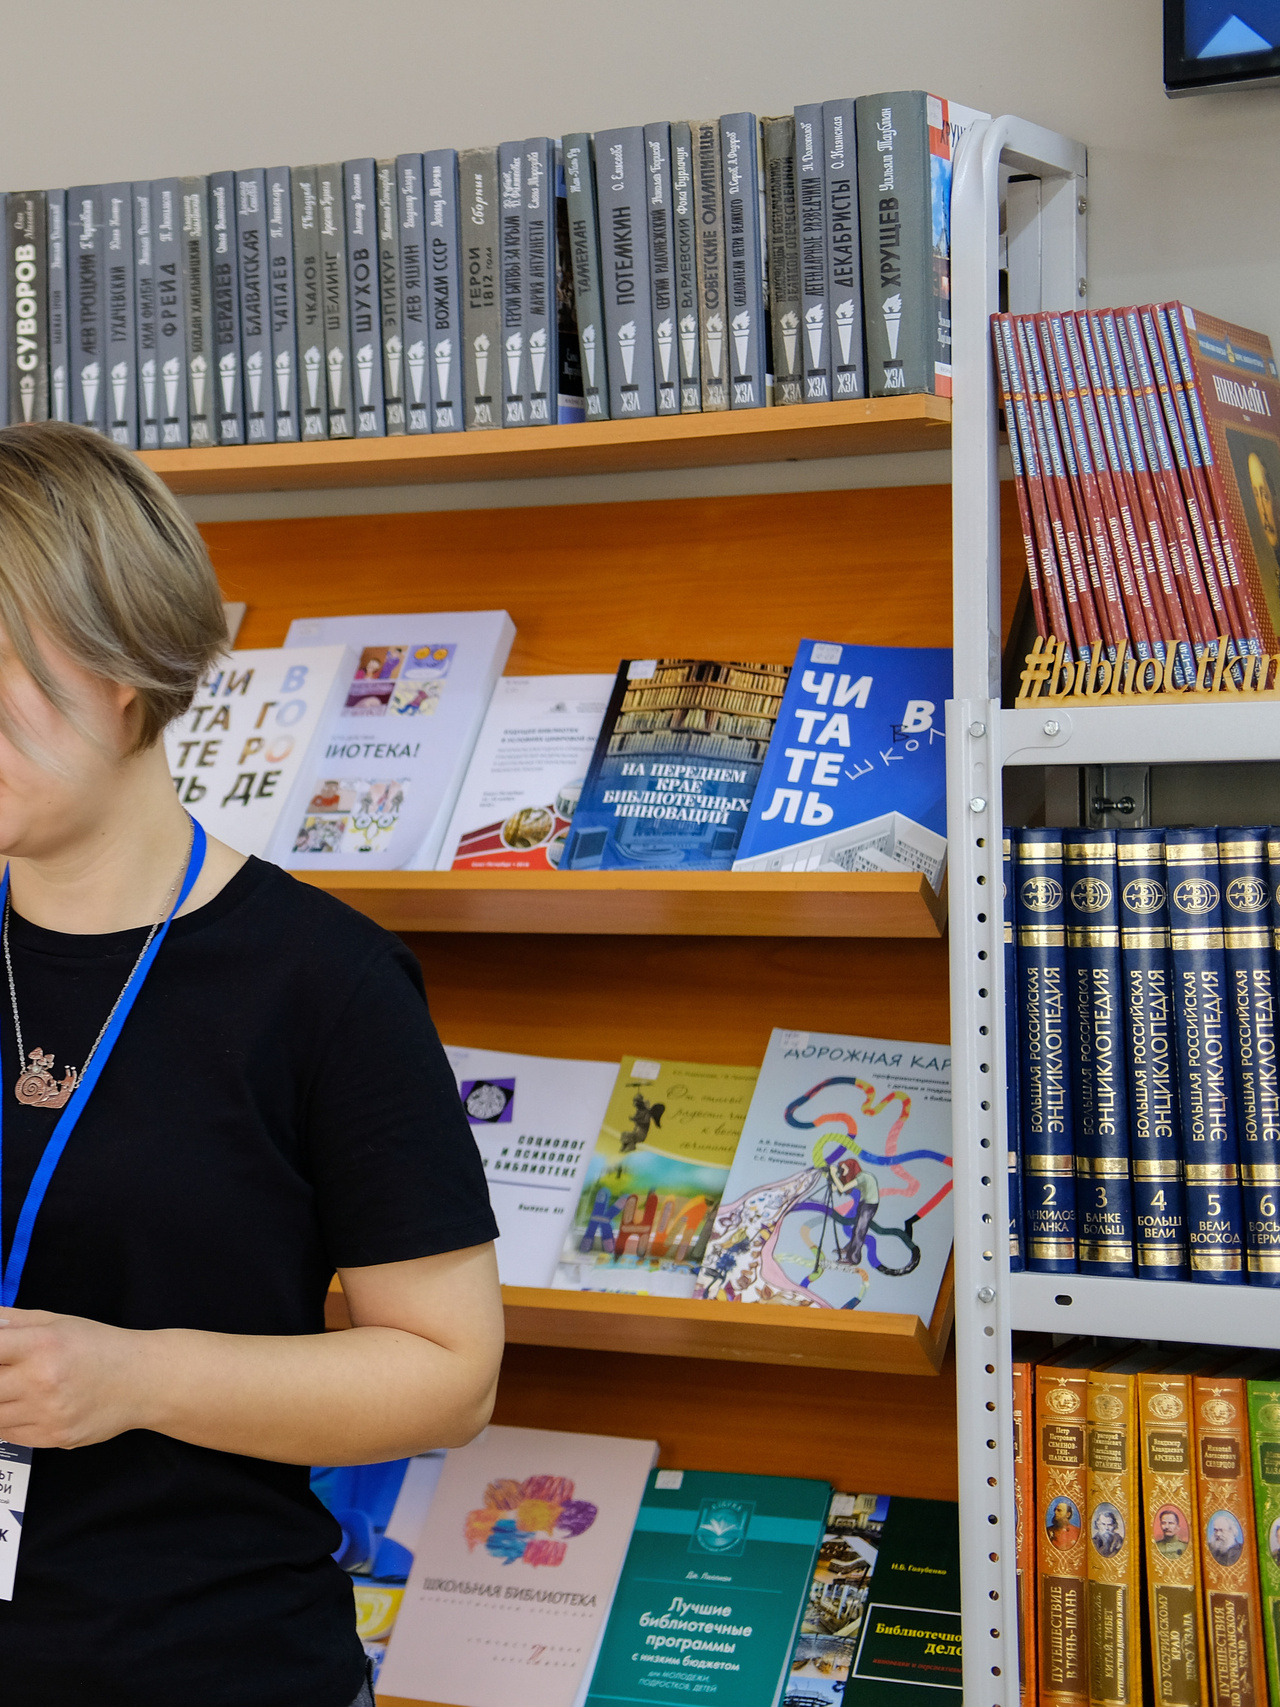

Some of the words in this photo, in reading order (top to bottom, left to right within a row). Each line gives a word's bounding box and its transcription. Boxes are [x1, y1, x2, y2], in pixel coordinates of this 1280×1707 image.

[831, 115, 844, 159] Киянская
[877, 107, 897, 151] Таубман
[675, 146, 690, 189] Бурлачук
[699, 126, 717, 224] ОЛИМПИЙЦЫ
[730, 199, 744, 233] ВЕЛИКОГО
[782, 156, 797, 248] ОТЕЧЕСТВЕННОЙ
[801, 177, 822, 231] РАЗВЕДЧИКИ
[504, 216, 520, 247] КРЫМ
[529, 220, 545, 278] АНТУАНЕТТА
[651, 208, 668, 273] РАДОНЕЖСКИЙ
[732, 237, 744, 257] ПЕТРА
[831, 179, 853, 288] ДЕКАБРИСТЫ
[879, 197, 901, 288] ХРУЩЕВ
[404, 245, 420, 287] ЯШИН
[433, 238, 447, 271] СССР
[573, 220, 591, 296] ТАМЕРЛАН
[612, 206, 635, 305] ПОТЕМКИН
[703, 230, 720, 309] СОВЕТСКИЕ
[802, 237, 824, 297] ЛЕГЕНДАРНЫЕ
[79, 254, 98, 323] ТРОЦКИЙ
[188, 240, 202, 313] ХМЕЛЬНИЦКИЙ
[243, 230, 262, 336] БЛАВАТСКАЯ
[273, 256, 288, 332] ЧАПАЕВ
[304, 256, 317, 325] ЧКАЛОВ
[325, 251, 340, 330] ШЕЛЛИНГ
[353, 248, 372, 332] ШУХОВ
[383, 250, 397, 327] ЭПИКУР
[469, 247, 482, 309] ГЕРОИ
[483, 275, 494, 307] 1812
[504, 263, 521, 295] БИТВЫ
[654, 278, 670, 309] СЕРГИЙ
[734, 260, 746, 307] СЛЕДОВАТЕЛИ
[15, 243, 38, 371] СУВОРОВ
[110, 266, 127, 342] ТУХАЧЕВСКИЙ
[140, 278, 154, 318] ФИЛБИ
[159, 263, 177, 337] ФРЕЙД
[216, 264, 235, 344] БЕРДЯЕВ
[407, 295, 422, 323] ЛЕВ
[433, 276, 449, 329] ВОЖДИ
[504, 298, 522, 327] ГЕРОИ
[530, 281, 545, 315] МАРИЯ
[142, 323, 155, 349] КИМ
[192, 315, 203, 352] БОГДАН
[1212, 375, 1265, 415] НИКОЛАЙ
[1053, 520, 1068, 554] СВЯТОЙ
[1094, 535, 1112, 577] ГРОЗНЫЙ
[1109, 517, 1126, 558] РОМАНОВ
[1148, 520, 1167, 571] ИОАННОВНА
[1041, 548, 1053, 576] ОЛЬГА
[1061, 556, 1078, 603] ВЛАДИМИР
[280, 665, 308, 693] В
[801, 670, 873, 708] ЧИ
[901, 700, 935, 733] В
[795, 709, 851, 747] ТА
[621, 762, 645, 777] НА
[650, 763, 747, 784] ПЕРЕДНЕМ
[655, 778, 703, 793] КРАЕ
[785, 748, 845, 787] ТЕ
[603, 791, 751, 813] БИБЛИОТЕЧНЫХ
[613, 804, 730, 825] ИННОВАЦИЙ
[761, 788, 834, 826] ЛЬ
[1027, 967, 1041, 1060] РОССИЙСКАЯ
[1077, 969, 1092, 1062] РОССИЙСКАЯ
[1130, 970, 1146, 1064] РОССИЙСКАЯ
[1183, 971, 1201, 1067] РОССИЙСКАЯ
[1236, 970, 1253, 1066] РОССИЙСКАЯ
[784, 1045, 902, 1067] ДОРОЖНАЯ
[1043, 967, 1066, 1133] ЭНЦИКЛОПЕДИЯ
[1093, 968, 1116, 1135] ЭНЦИКЛОПЕДИЯ
[1148, 970, 1173, 1138] ЭНЦИКЛОПЕДИЯ
[1201, 971, 1228, 1141] ЭНЦИКЛОПЕДИЯ
[1253, 969, 1280, 1141] ЭНЦИКЛОПЕДИЯ
[1030, 1066, 1043, 1133] БОЛЬШАЯ
[1081, 1068, 1094, 1135] БОЛЬШАЯ
[1135, 1070, 1150, 1138] БОЛЬШАЯ
[1189, 1073, 1205, 1141] БОЛЬШАЯ
[1242, 1072, 1258, 1141] БОЛЬШАЯ
[501, 1148, 509, 1156] И
[515, 1149, 581, 1164] ПСИХОЛОГ
[518, 1135, 586, 1150] СОЦИОЛОГ
[495, 1160, 577, 1178] БИБЛИОТЕКЕ
[1042, 1184, 1057, 1206] 2
[1096, 1187, 1108, 1208] 3
[1150, 1190, 1167, 1211] 4
[1207, 1194, 1221, 1216] 5
[1259, 1194, 1276, 1217] 6
[1033, 1221, 1069, 1232] БАНКА
[1084, 1224, 1125, 1235] БОЛЬШ
[1086, 1212, 1121, 1223] БАНКЕ
[1137, 1216, 1182, 1227] БОЛЬШ
[1144, 1227, 1176, 1238] ВЕЛИ
[1199, 1221, 1231, 1232] ВЕЛИ
[1190, 1233, 1242, 1244] ВОСХОД
[1154, 1454, 1183, 1463] АРСЕНЬЕВ
[908, 1564, 947, 1575] Голубенко
[422, 1577, 502, 1598] ШКОЛЬНАЯ
[504, 1586, 597, 1607] БИБЛИОТЕКА
[668, 1597, 732, 1617] Лучшие
[639, 1611, 753, 1637] библиотечные
[645, 1634, 736, 1654] программы
[1050, 1586, 1063, 1683] ПУТЕШЕСТВИЕ
[1065, 1589, 1077, 1669] ТЯНЬ-ШАНЬ
[1104, 1608, 1113, 1640] ТИБЕТ
[1157, 1593, 1172, 1678] УССУРИЙСКОМУ
[1183, 1612, 1194, 1646] УЗАЛА
[640, 1654, 680, 1665] низким
[682, 1655, 740, 1671] бюджетом
[1170, 1630, 1181, 1660] КРАЮ
[1213, 1607, 1230, 1697] ПУТЕШЕСТВИЯ
[1225, 1599, 1240, 1690] ТУРКЕСТАНСКОМУ
[1238, 1640, 1248, 1668] КРАЮ
[692, 1684, 717, 1693] ДЕТЕЙ
[1066, 1671, 1077, 1679] В
[1163, 1680, 1173, 1696] ПО
[1230, 1692, 1241, 1707] ПО
